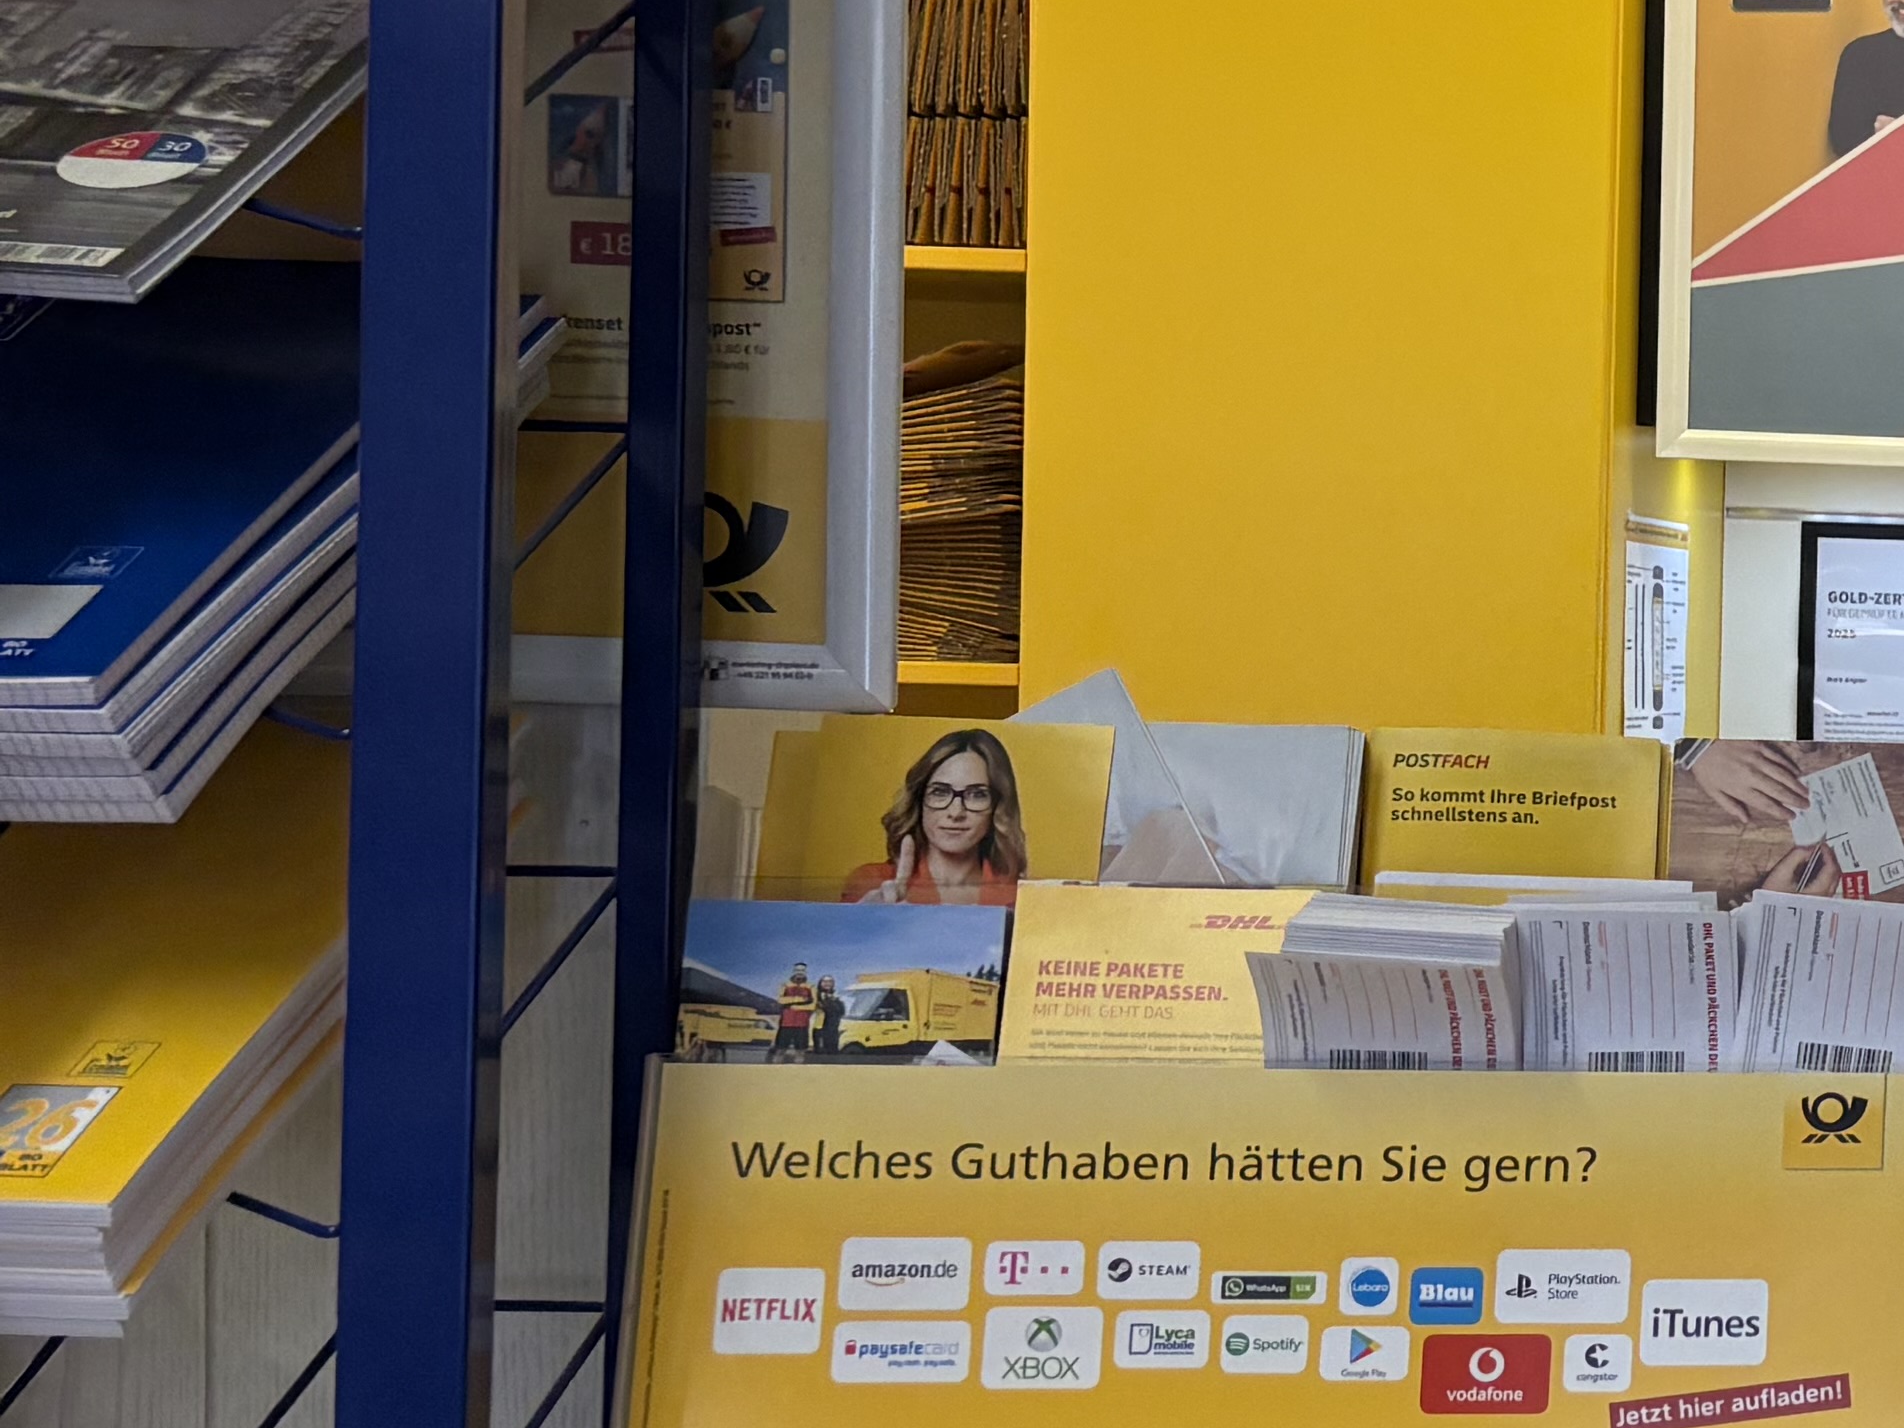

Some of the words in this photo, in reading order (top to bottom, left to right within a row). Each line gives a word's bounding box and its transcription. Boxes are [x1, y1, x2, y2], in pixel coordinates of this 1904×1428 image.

[1827, 628, 1856, 638] 2025
[1393, 752, 1490, 769] POSTFACH
[1392, 787, 1415, 803] So
[1419, 788, 1486, 805] kommt
[1491, 789, 1527, 805] Ihre
[1532, 790, 1617, 811] Briefpost
[1391, 804, 1507, 824] schnellstens
[1511, 810, 1540, 825] an.
[1038, 959, 1100, 979] KEINE
[1105, 961, 1184, 980] PAKETE
[1036, 981, 1097, 1000] MEHR
[1101, 983, 1229, 1003] VERPASSEN.
[731, 1141, 932, 1180] Welches
[951, 1142, 1190, 1181] Guthaben
[1209, 1143, 1363, 1182] hätten
[1382, 1145, 1445, 1182] Sie
[1464, 1146, 1597, 1192] gern?
[851, 1260, 958, 1280] amazon.de
[1138, 1264, 1187, 1276] STEAM
[1547, 1274, 1616, 1287] PlayStation
[1419, 1282, 1474, 1303] Blau
[1547, 1287, 1579, 1300] Store
[721, 1298, 817, 1322] NETFLIX
[1652, 1309, 1759, 1338] iTunes
[1252, 1337, 1302, 1353] Spotify
[1002, 1356, 1080, 1380] XBOX
[1447, 1387, 1523, 1403] vodafone
[1678, 1394, 1725, 1419] hier
[1731, 1382, 1844, 1414] aufladen!
